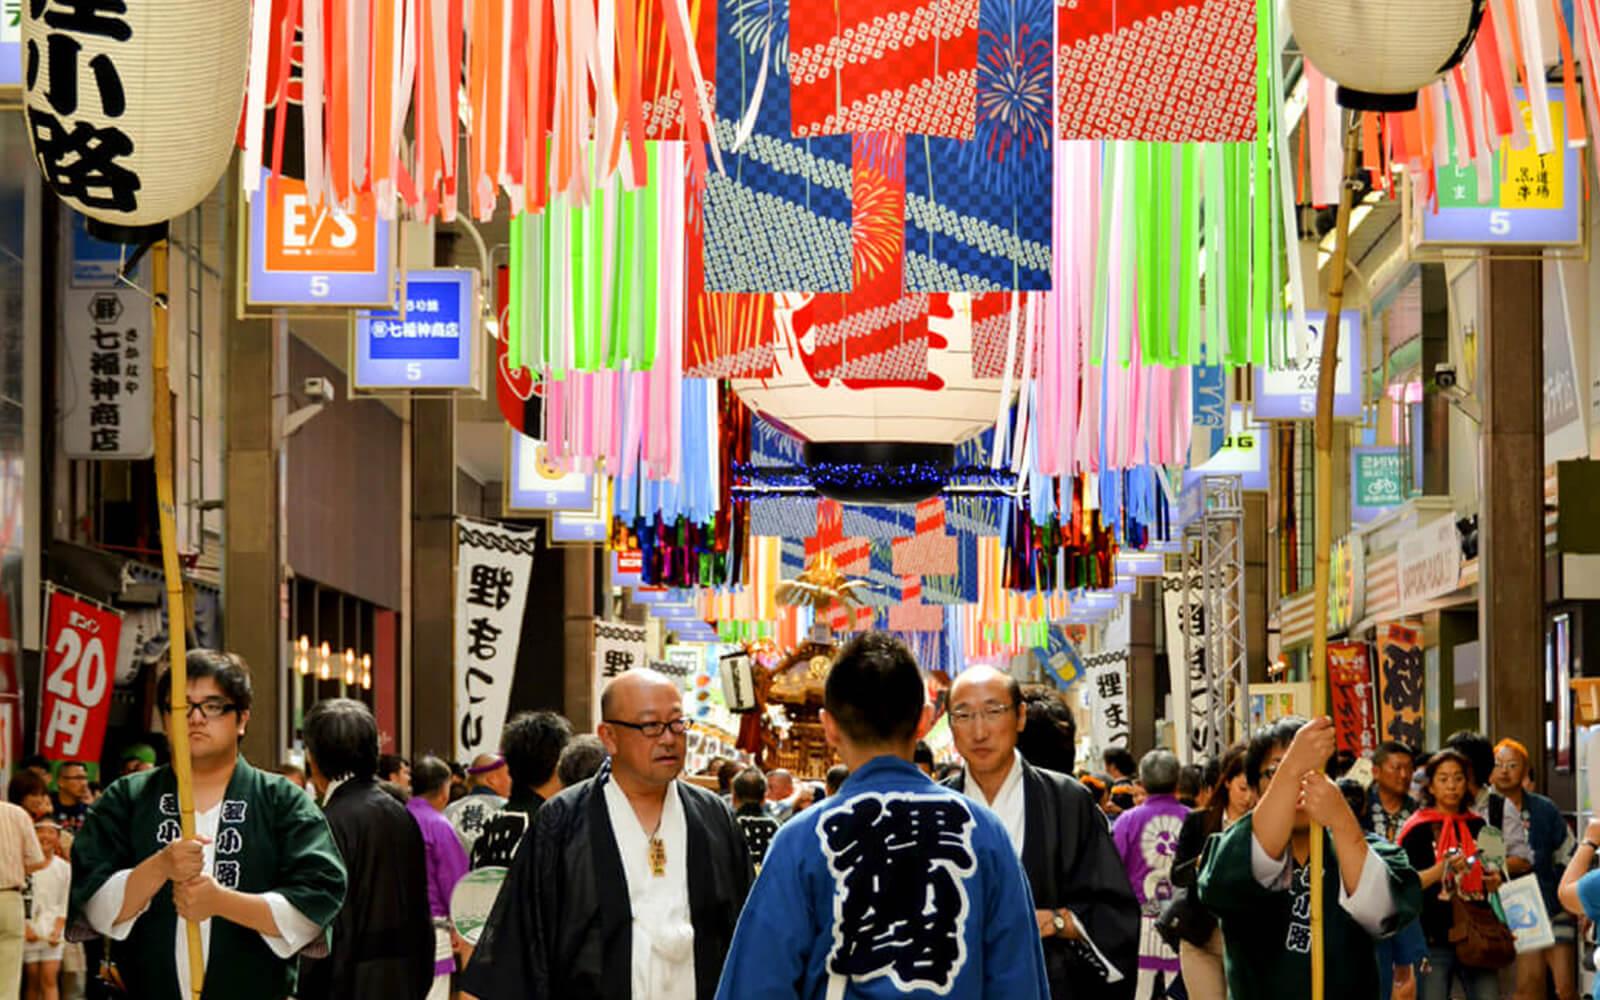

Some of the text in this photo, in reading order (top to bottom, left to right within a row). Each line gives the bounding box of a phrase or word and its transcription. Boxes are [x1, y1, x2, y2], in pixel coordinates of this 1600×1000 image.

[283, 194, 358, 248] E/S
[1489, 211, 1511, 235] 5
[310, 275, 330, 297] 5
[406, 362, 422, 381] 5
[47, 627, 107, 708] 20
[45, 698, 89, 757] 円
